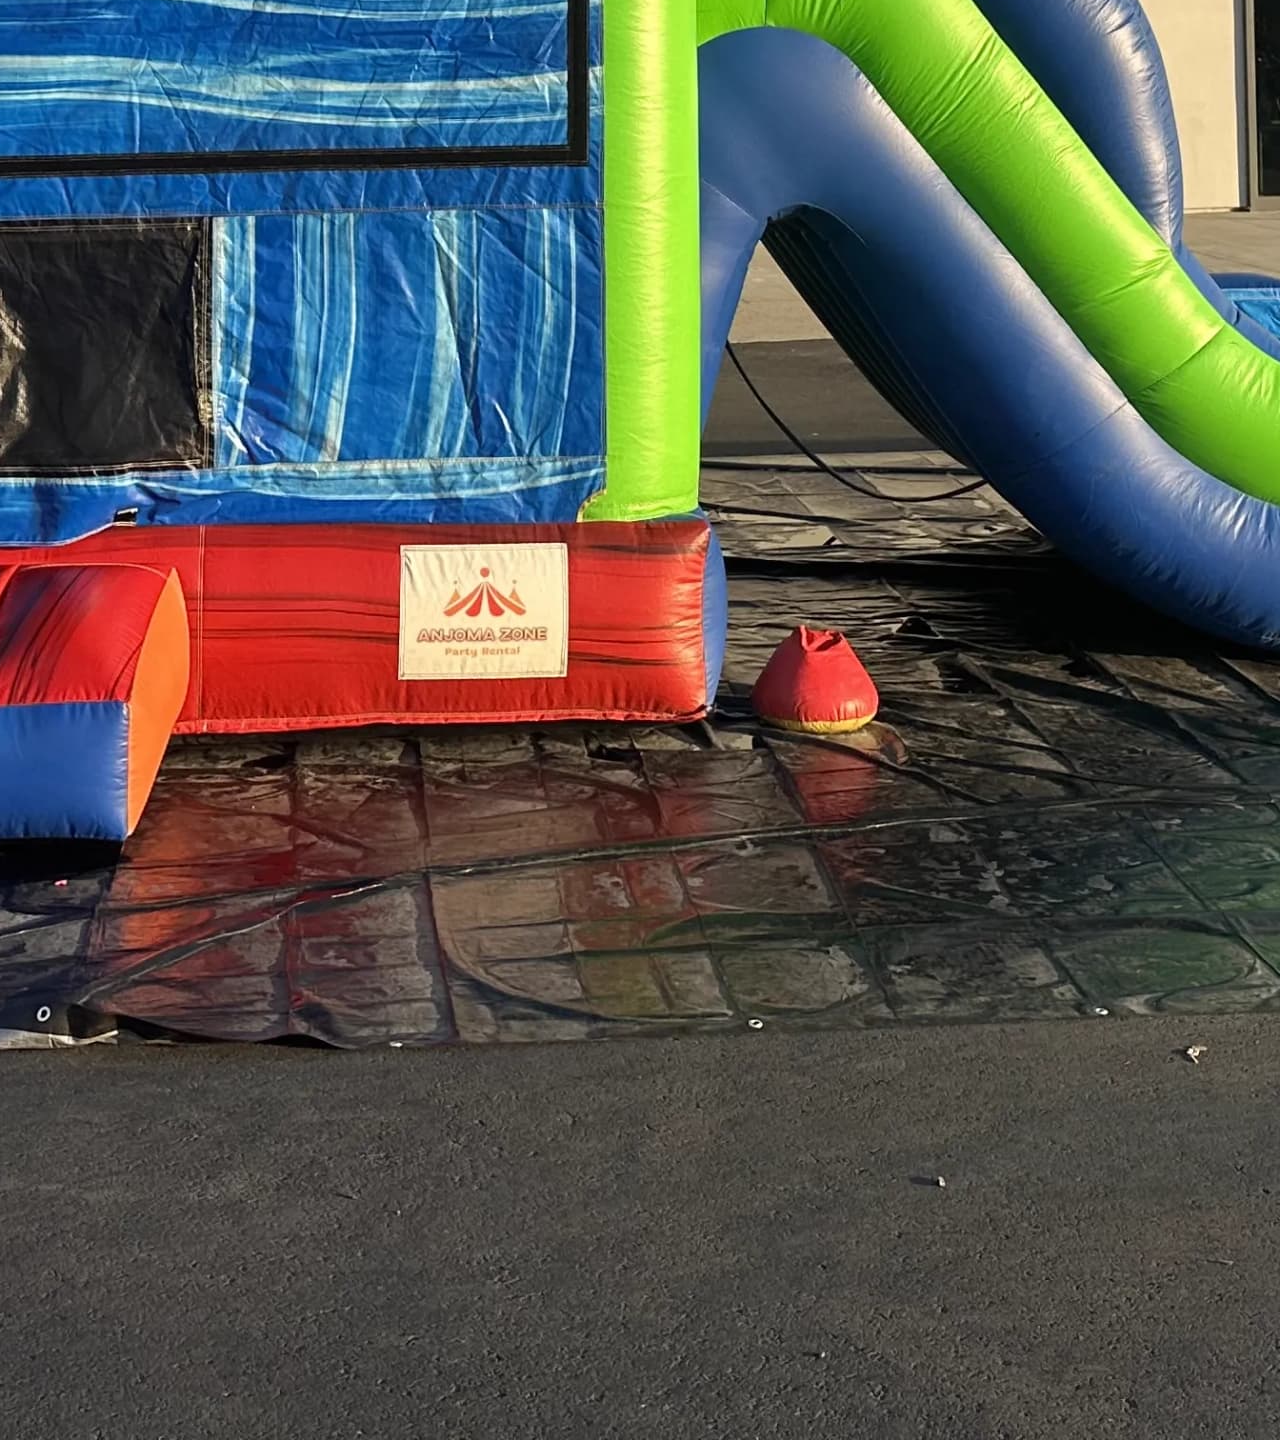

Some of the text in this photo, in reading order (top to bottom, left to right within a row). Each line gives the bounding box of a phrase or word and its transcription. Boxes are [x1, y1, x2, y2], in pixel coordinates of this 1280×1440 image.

[417, 626, 548, 643] ANJOMA ZONE
[445, 646, 520, 657] Party Rental
